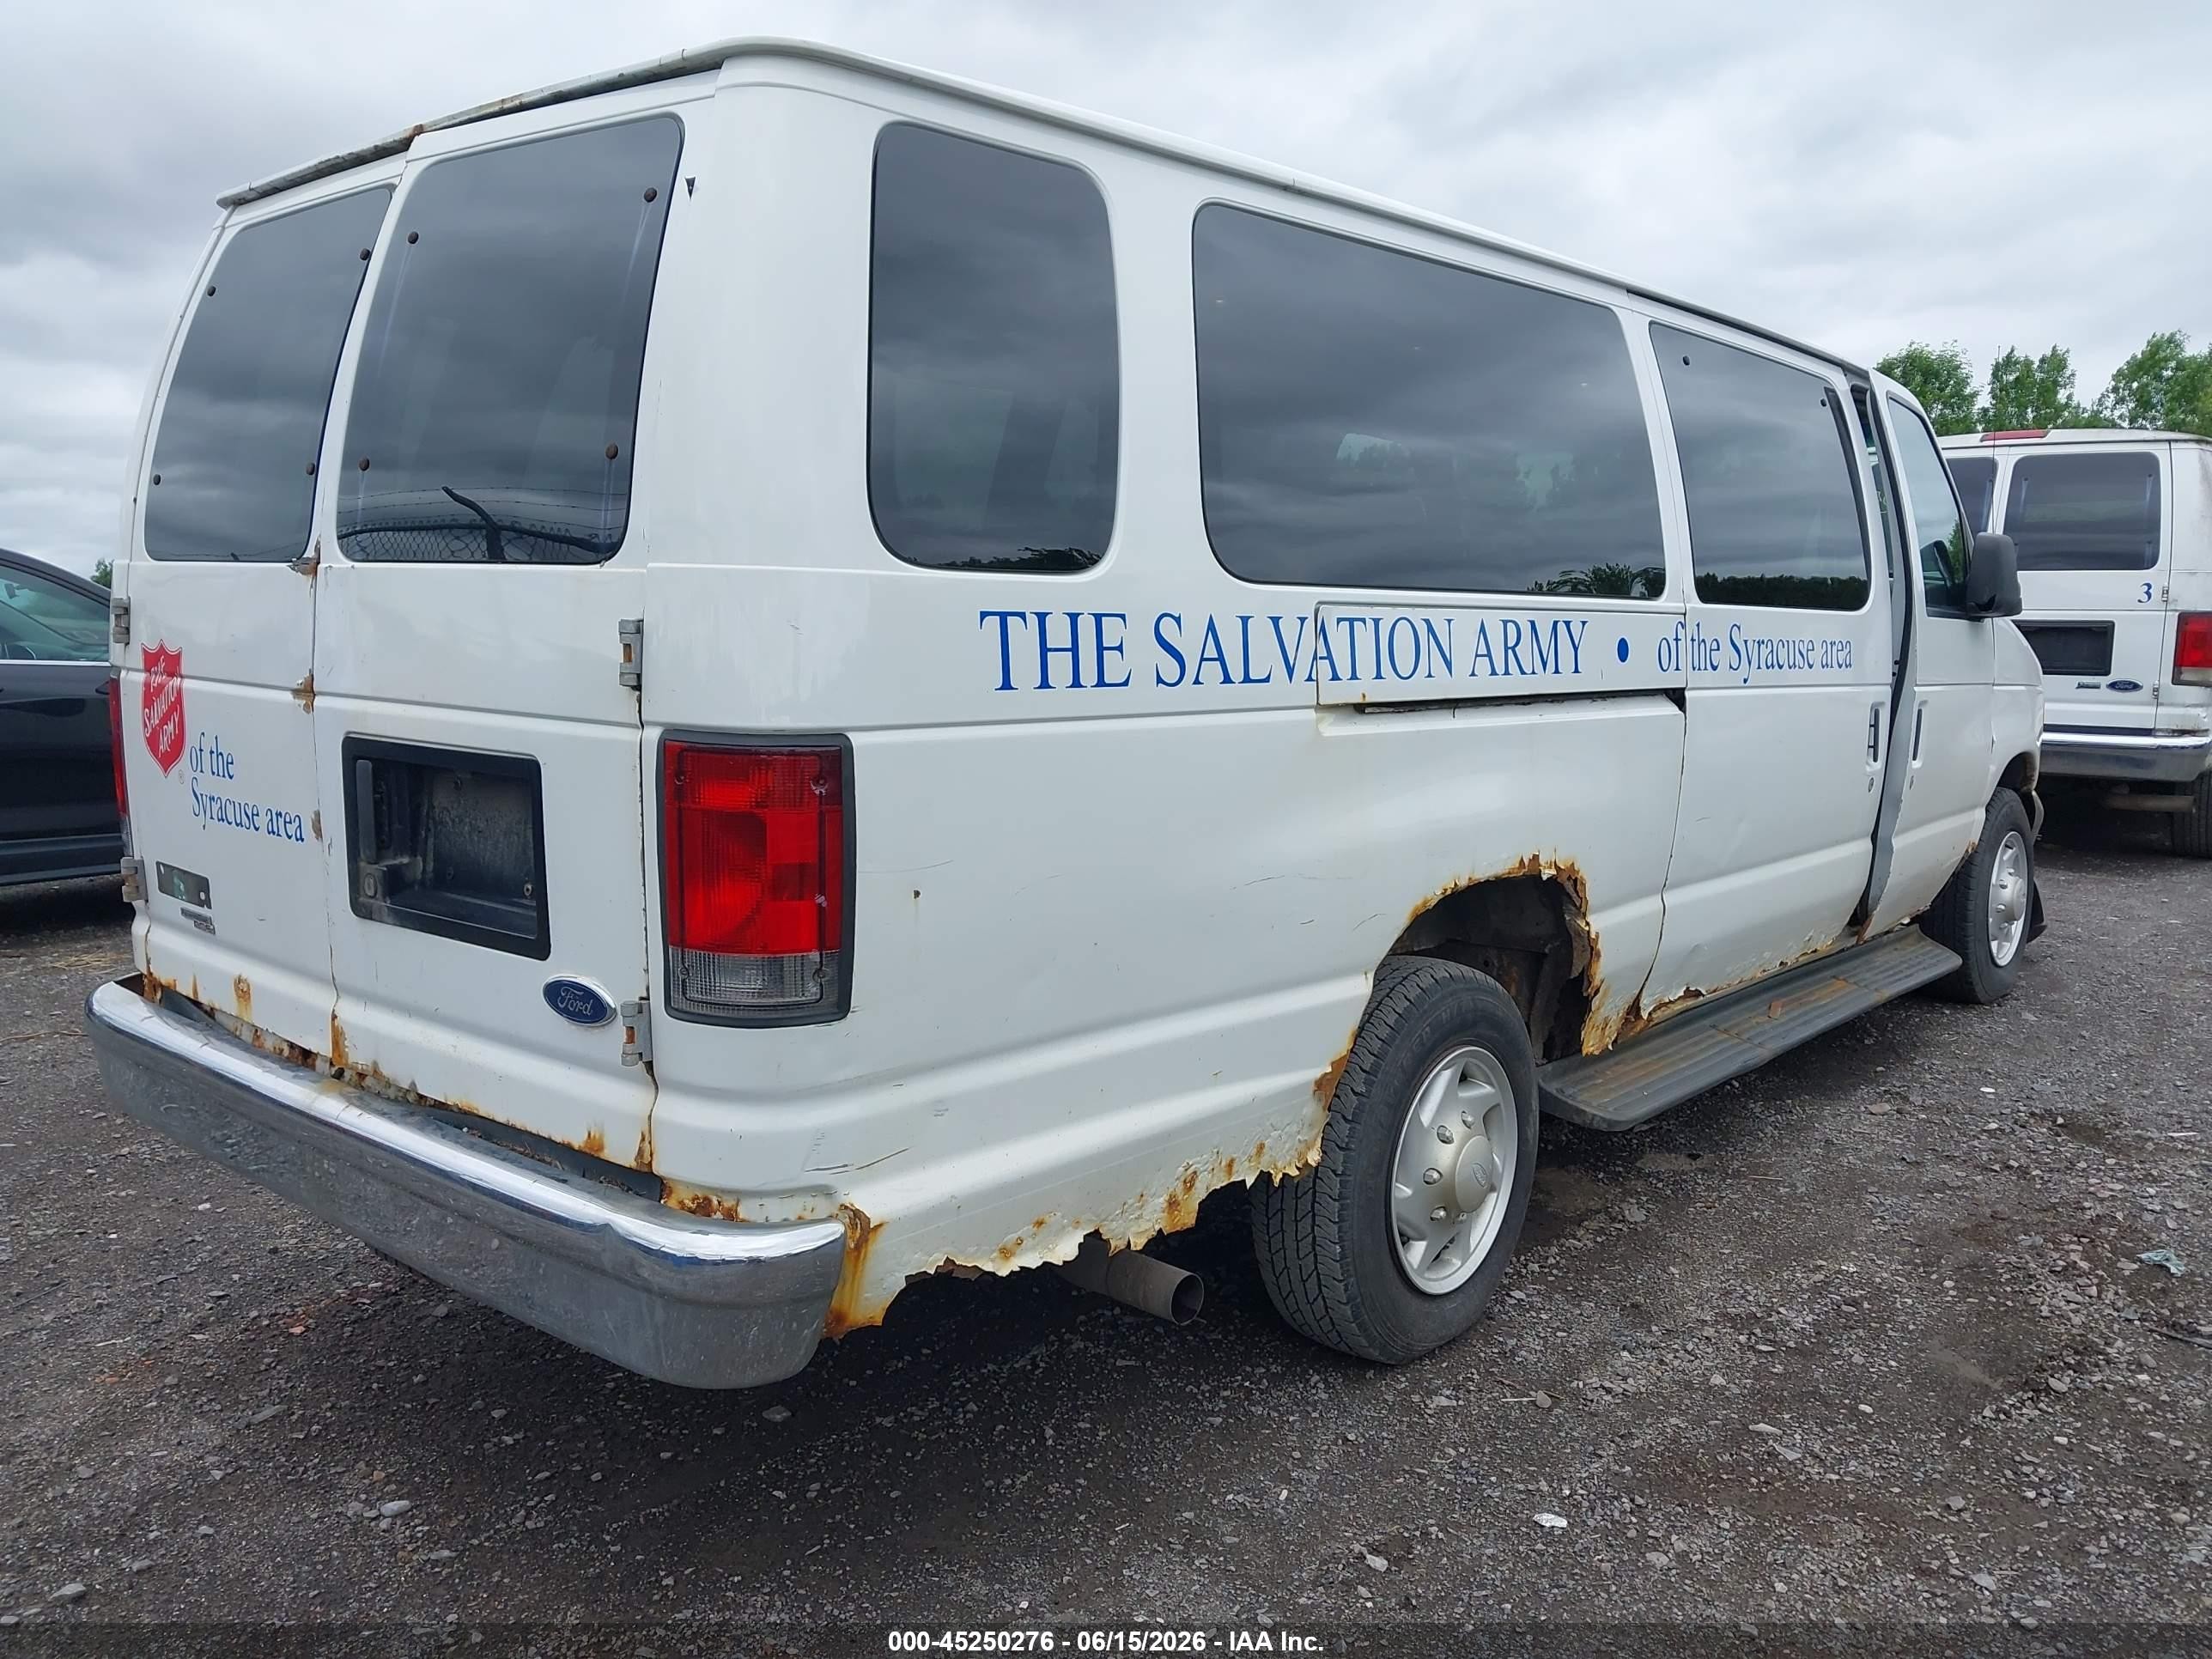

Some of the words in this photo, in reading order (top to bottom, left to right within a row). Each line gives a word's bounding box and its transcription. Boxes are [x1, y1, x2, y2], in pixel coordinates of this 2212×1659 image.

[2137, 582, 2153, 604] 3
[150, 655, 166, 692] THE
[979, 611, 1133, 691] THE
[1153, 611, 1455, 688] SALVATION
[1469, 618, 1589, 678] ARMY
[1656, 620, 1685, 673] of
[1687, 623, 1720, 672] the
[1728, 622, 1817, 685] Syracuse
[1820, 637, 1853, 671] area
[143, 666, 181, 738] SALVATION
[159, 704, 180, 758] ARMY
[189, 732, 206, 774] of
[209, 735, 234, 781] the
[191, 776, 259, 830] Syracuse
[266, 807, 305, 842] area
[558, 986, 593, 1016] Ford
